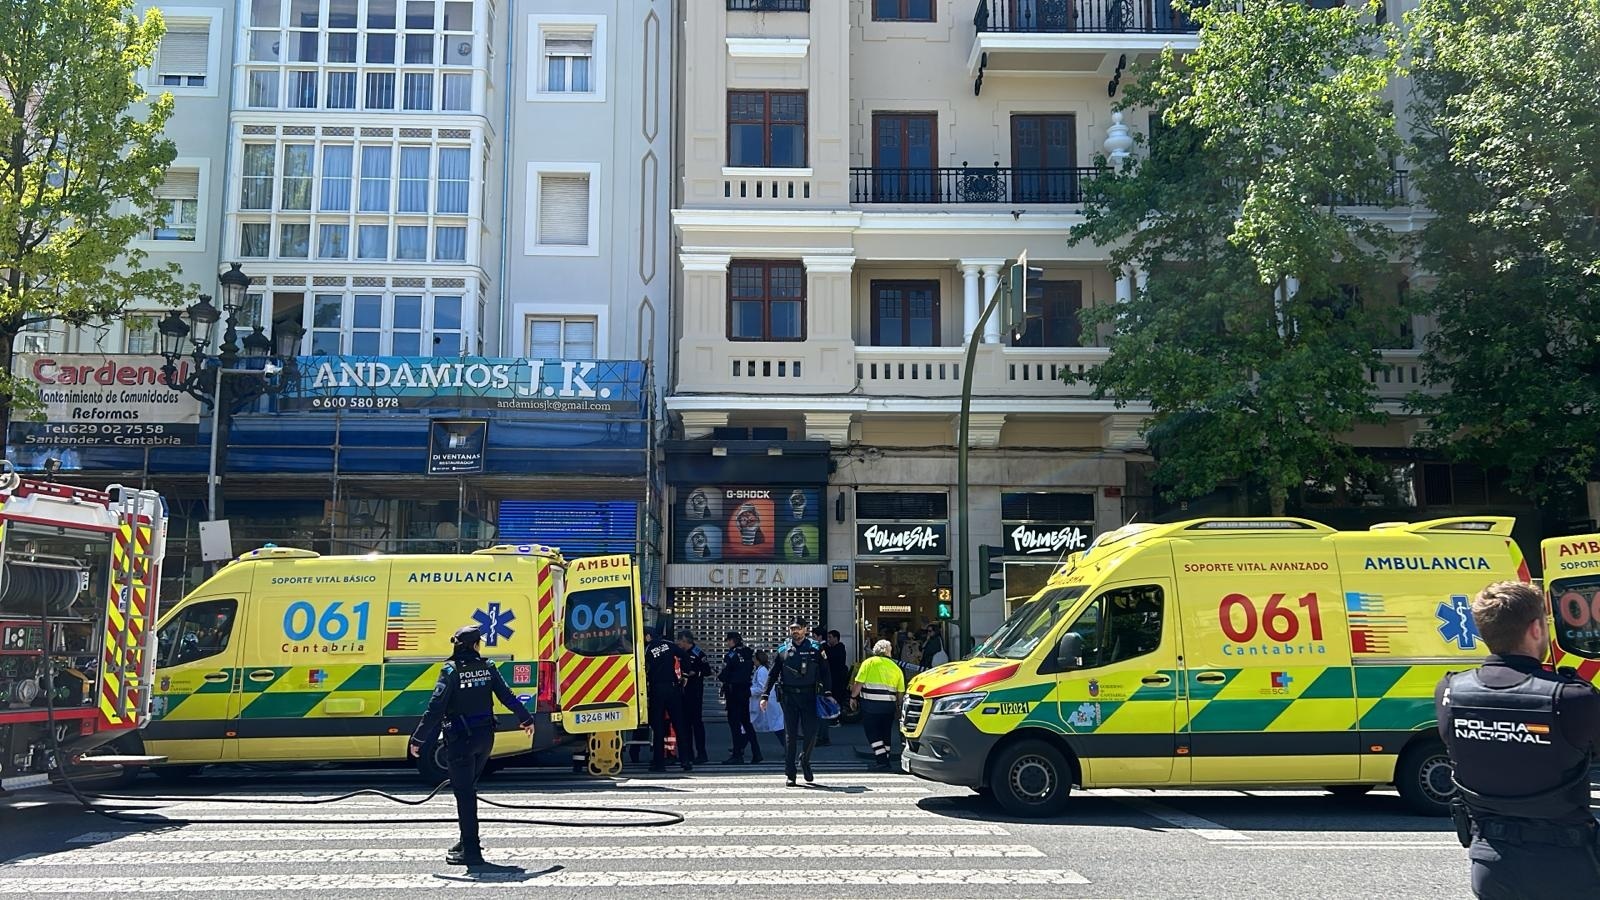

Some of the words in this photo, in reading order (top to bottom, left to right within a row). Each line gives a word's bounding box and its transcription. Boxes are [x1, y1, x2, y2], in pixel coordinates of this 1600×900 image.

[313, 362, 509, 389] ANDAMIOS
[518, 360, 611, 398] J.K.
[38, 390, 103, 404] Mantenimiento
[105, 390, 118, 404] de
[121, 390, 179, 404] Comunidades
[323, 398, 346, 408] 600
[350, 398, 373, 408] 580
[377, 398, 399, 408] 878
[497, 400, 611, 411] andamiosjk@gmail.com
[72, 407, 139, 419] Reformas
[44, 424, 98, 434] Tel.629
[101, 424, 121, 434] 02
[127, 424, 143, 434] 75
[146, 424, 164, 434] 58
[25, 435, 101, 444] Santander
[114, 435, 181, 445] Cantabria
[726, 490, 770, 499] G-SHOCK
[576, 557, 629, 572] AMBUL
[1184, 563, 1233, 572] SOPORTE
[1237, 562, 1267, 571] VITAL
[1270, 562, 1329, 571] AVANZADO
[1364, 557, 1491, 570] AMBULANCIA
[271, 576, 313, 584] SOPORTE
[343, 575, 376, 583] BÁSICO
[408, 572, 514, 583] AMBULANCIA
[580, 574, 620, 584] SOPORTE
[709, 568, 785, 585] CIEZA
[939, 589, 951, 600] 23
[283, 601, 370, 641] 061
[571, 601, 628, 631] 061
[1218, 592, 1323, 643] 061
[572, 629, 628, 640] Cantabria
[281, 642, 364, 653] Cantabria
[1222, 644, 1326, 656] Cantabria
[459, 669, 491, 680] POLICIA
[1002, 702, 1028, 714] U2021
[581, 713, 603, 722] 3246
[604, 711, 621, 721] MNT
[1454, 718, 1529, 733] POLICIA
